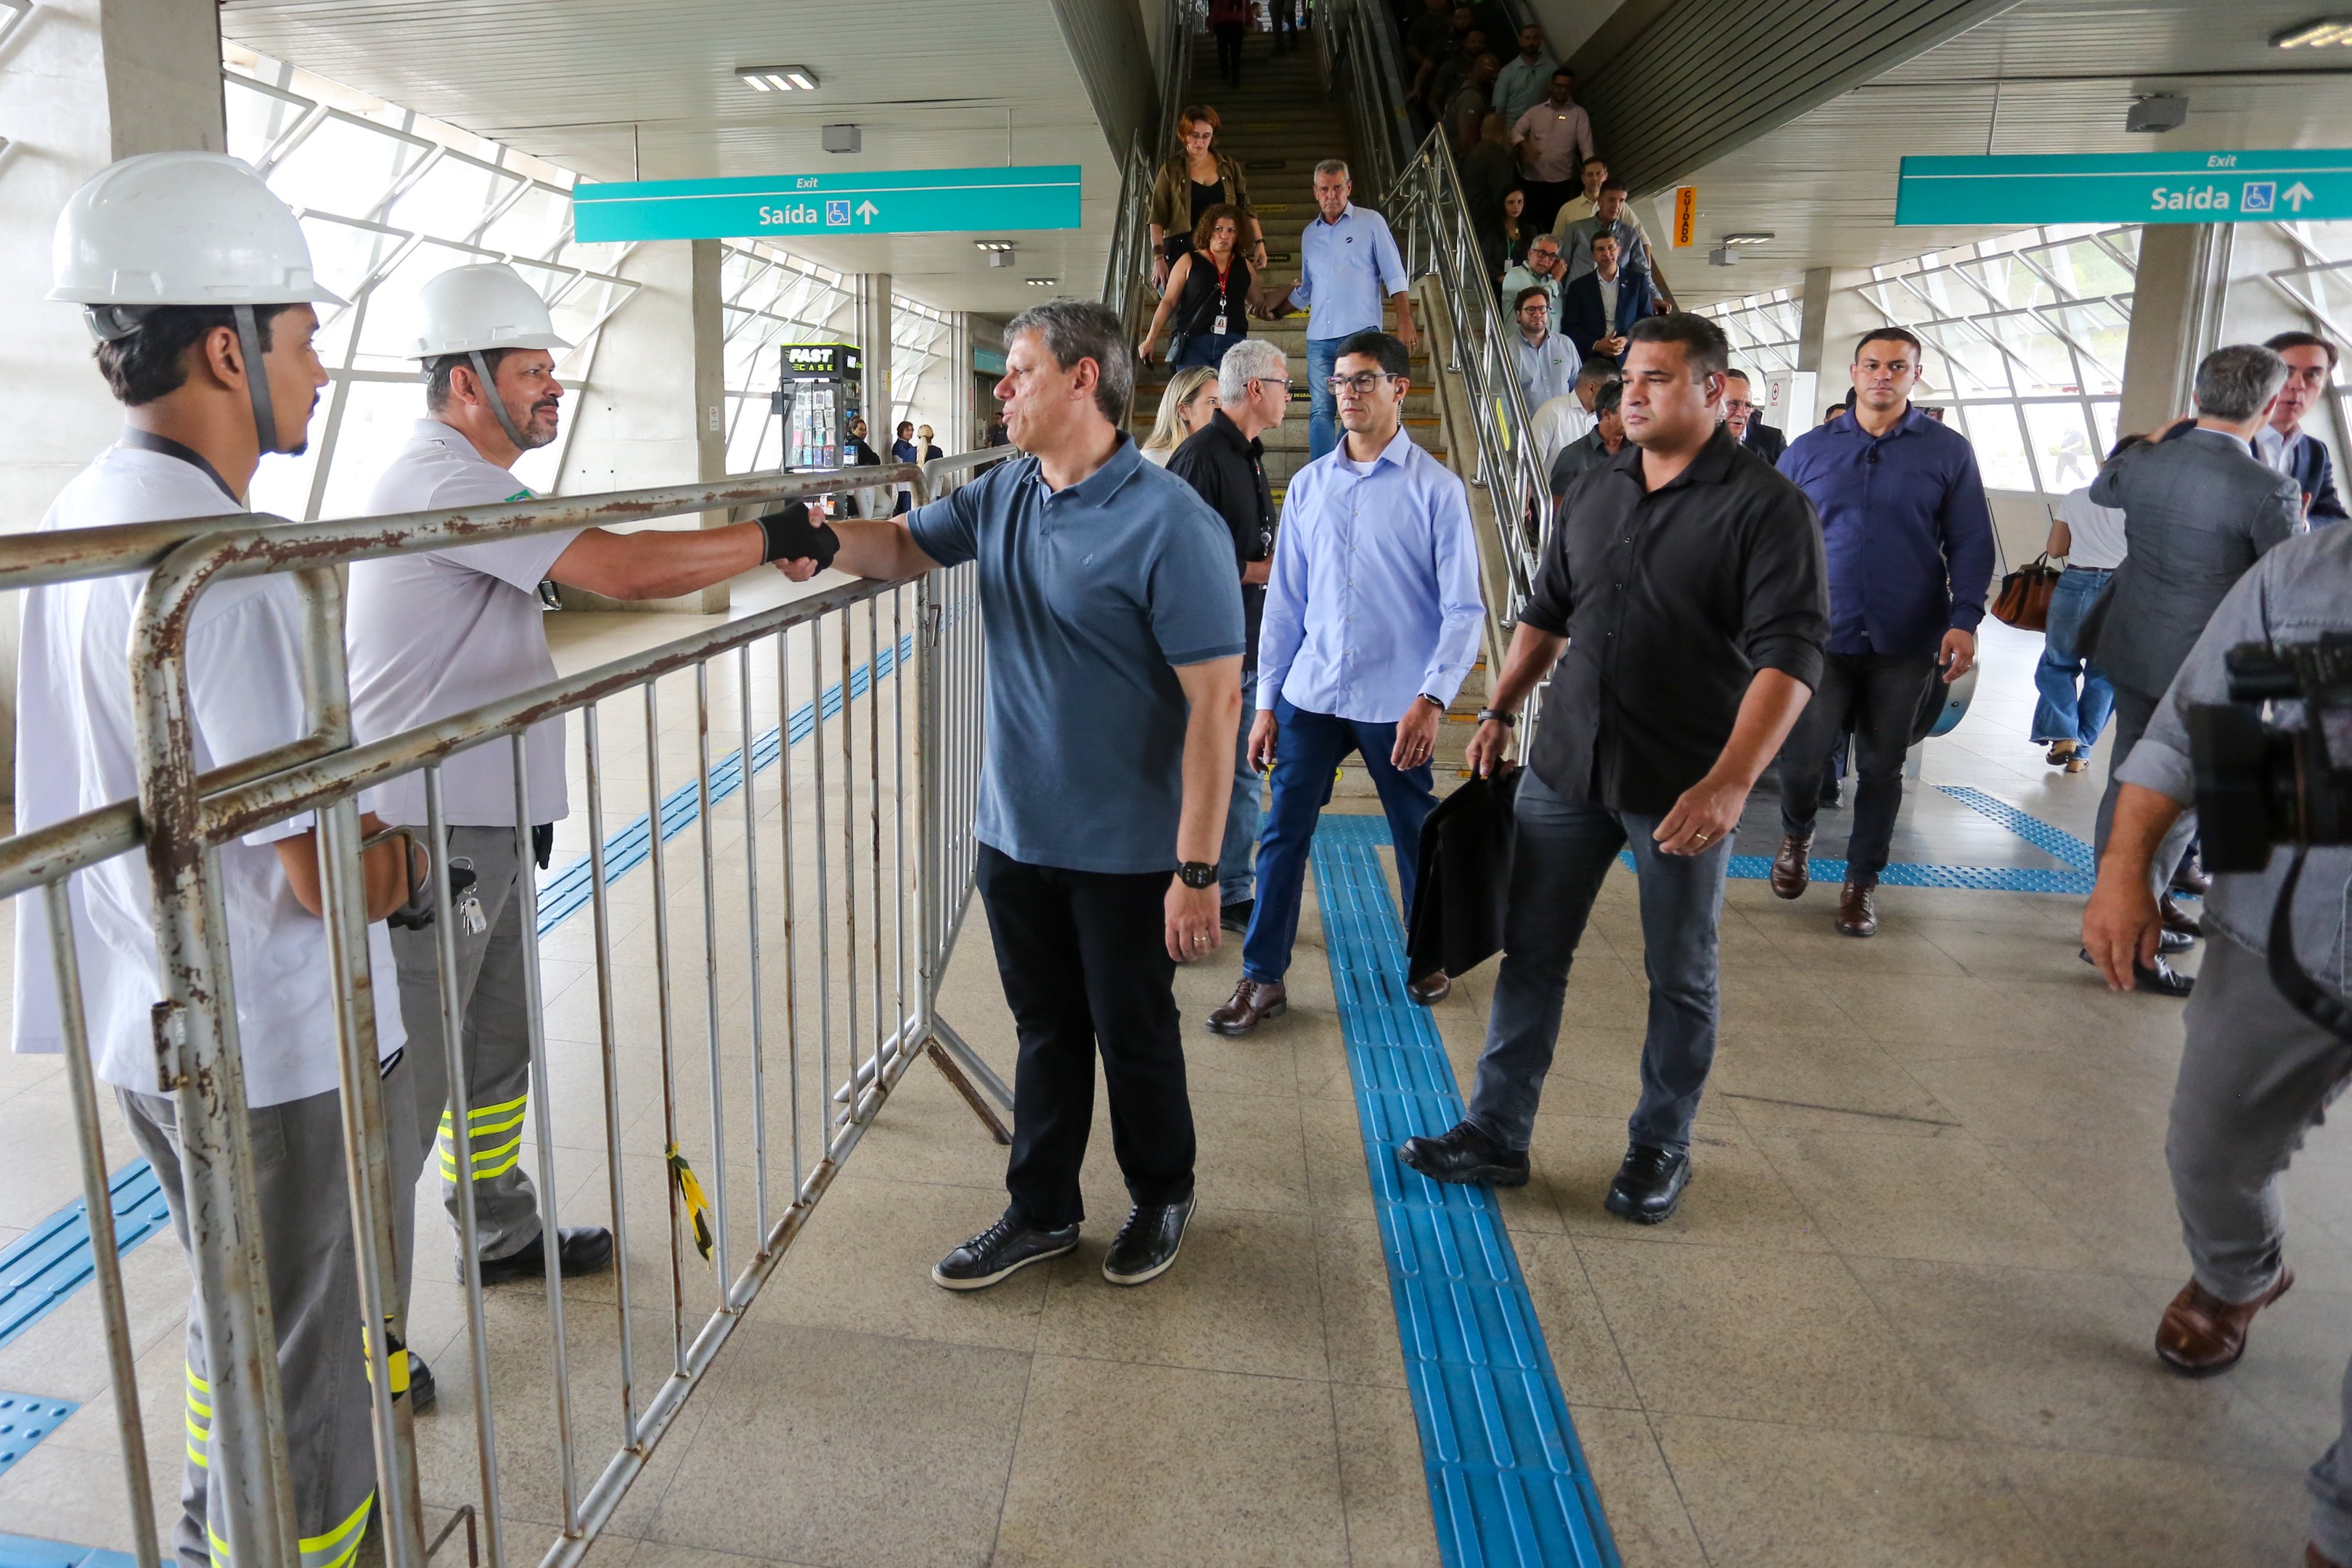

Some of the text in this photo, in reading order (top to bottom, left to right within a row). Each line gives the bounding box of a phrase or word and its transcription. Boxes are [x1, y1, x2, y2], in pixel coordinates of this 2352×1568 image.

[2207, 155, 2238, 167] Exit
[796, 177, 818, 189] Exit
[2150, 185, 2230, 211] Saída
[759, 203, 817, 225] Saída
[1681, 190, 1691, 243] CUIDADO
[788, 348, 833, 363] FAST
